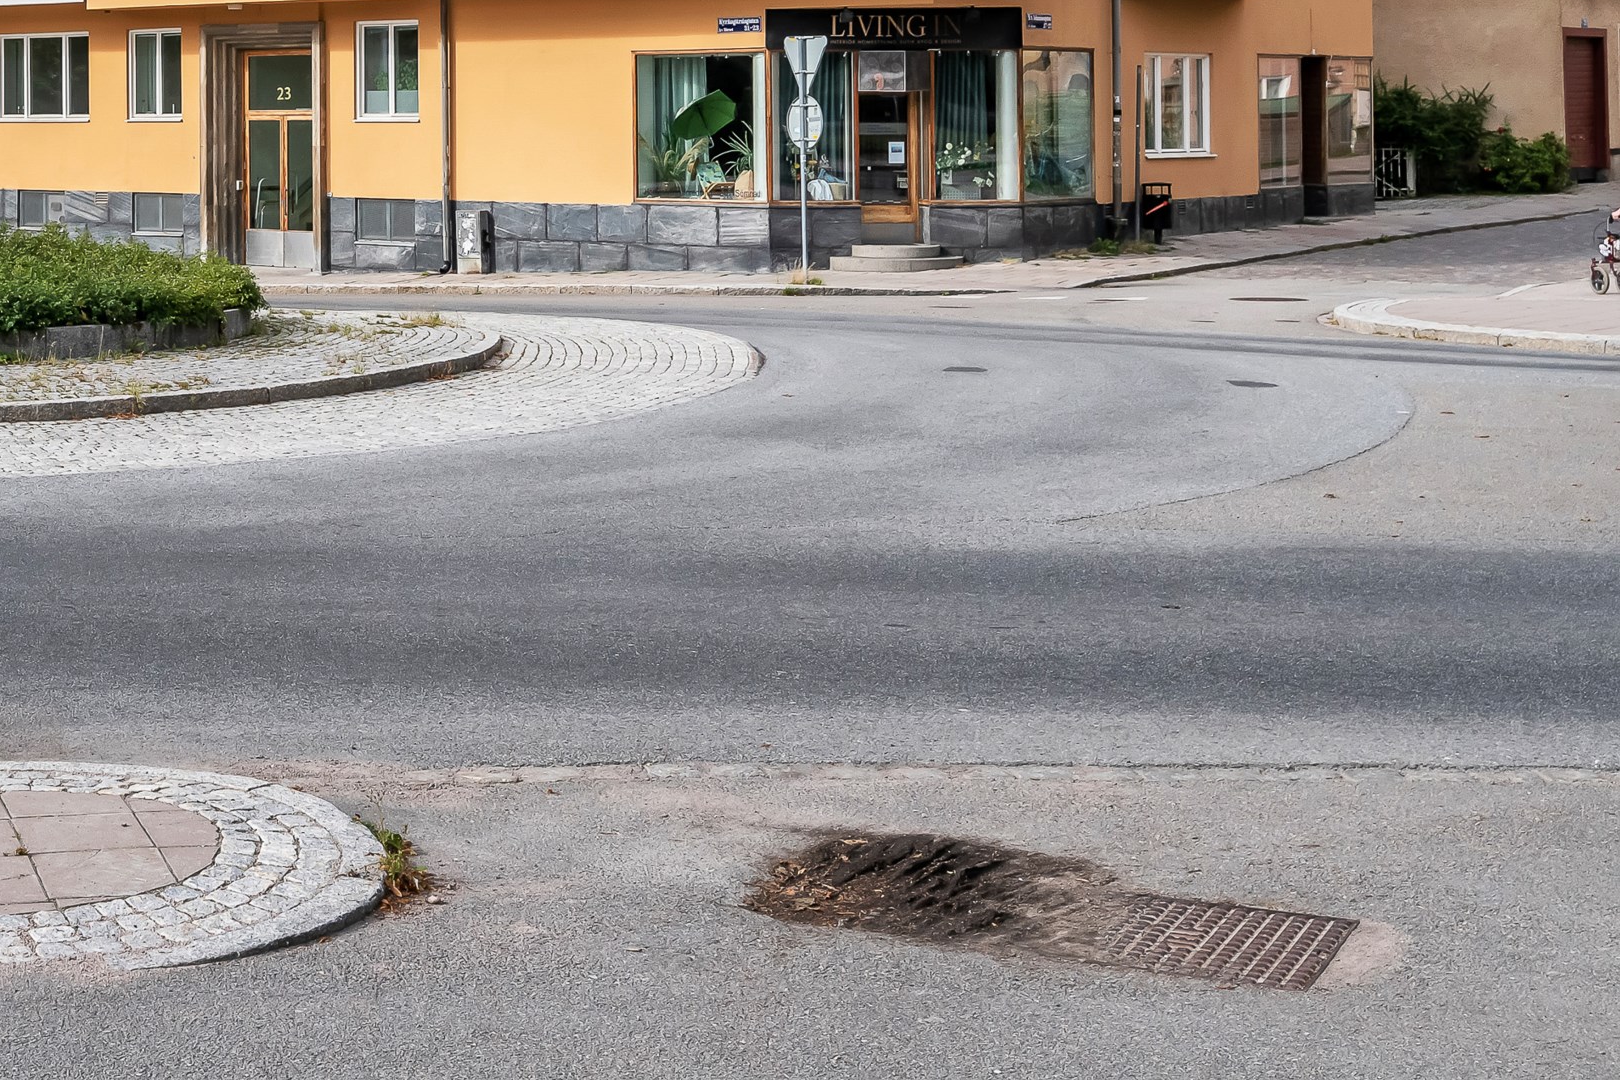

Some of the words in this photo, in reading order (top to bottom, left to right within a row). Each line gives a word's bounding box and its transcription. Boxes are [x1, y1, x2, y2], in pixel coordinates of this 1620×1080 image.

[830, 14, 927, 38] LIVING
[933, 14, 962, 36] IN
[276, 86, 292, 101] 23
